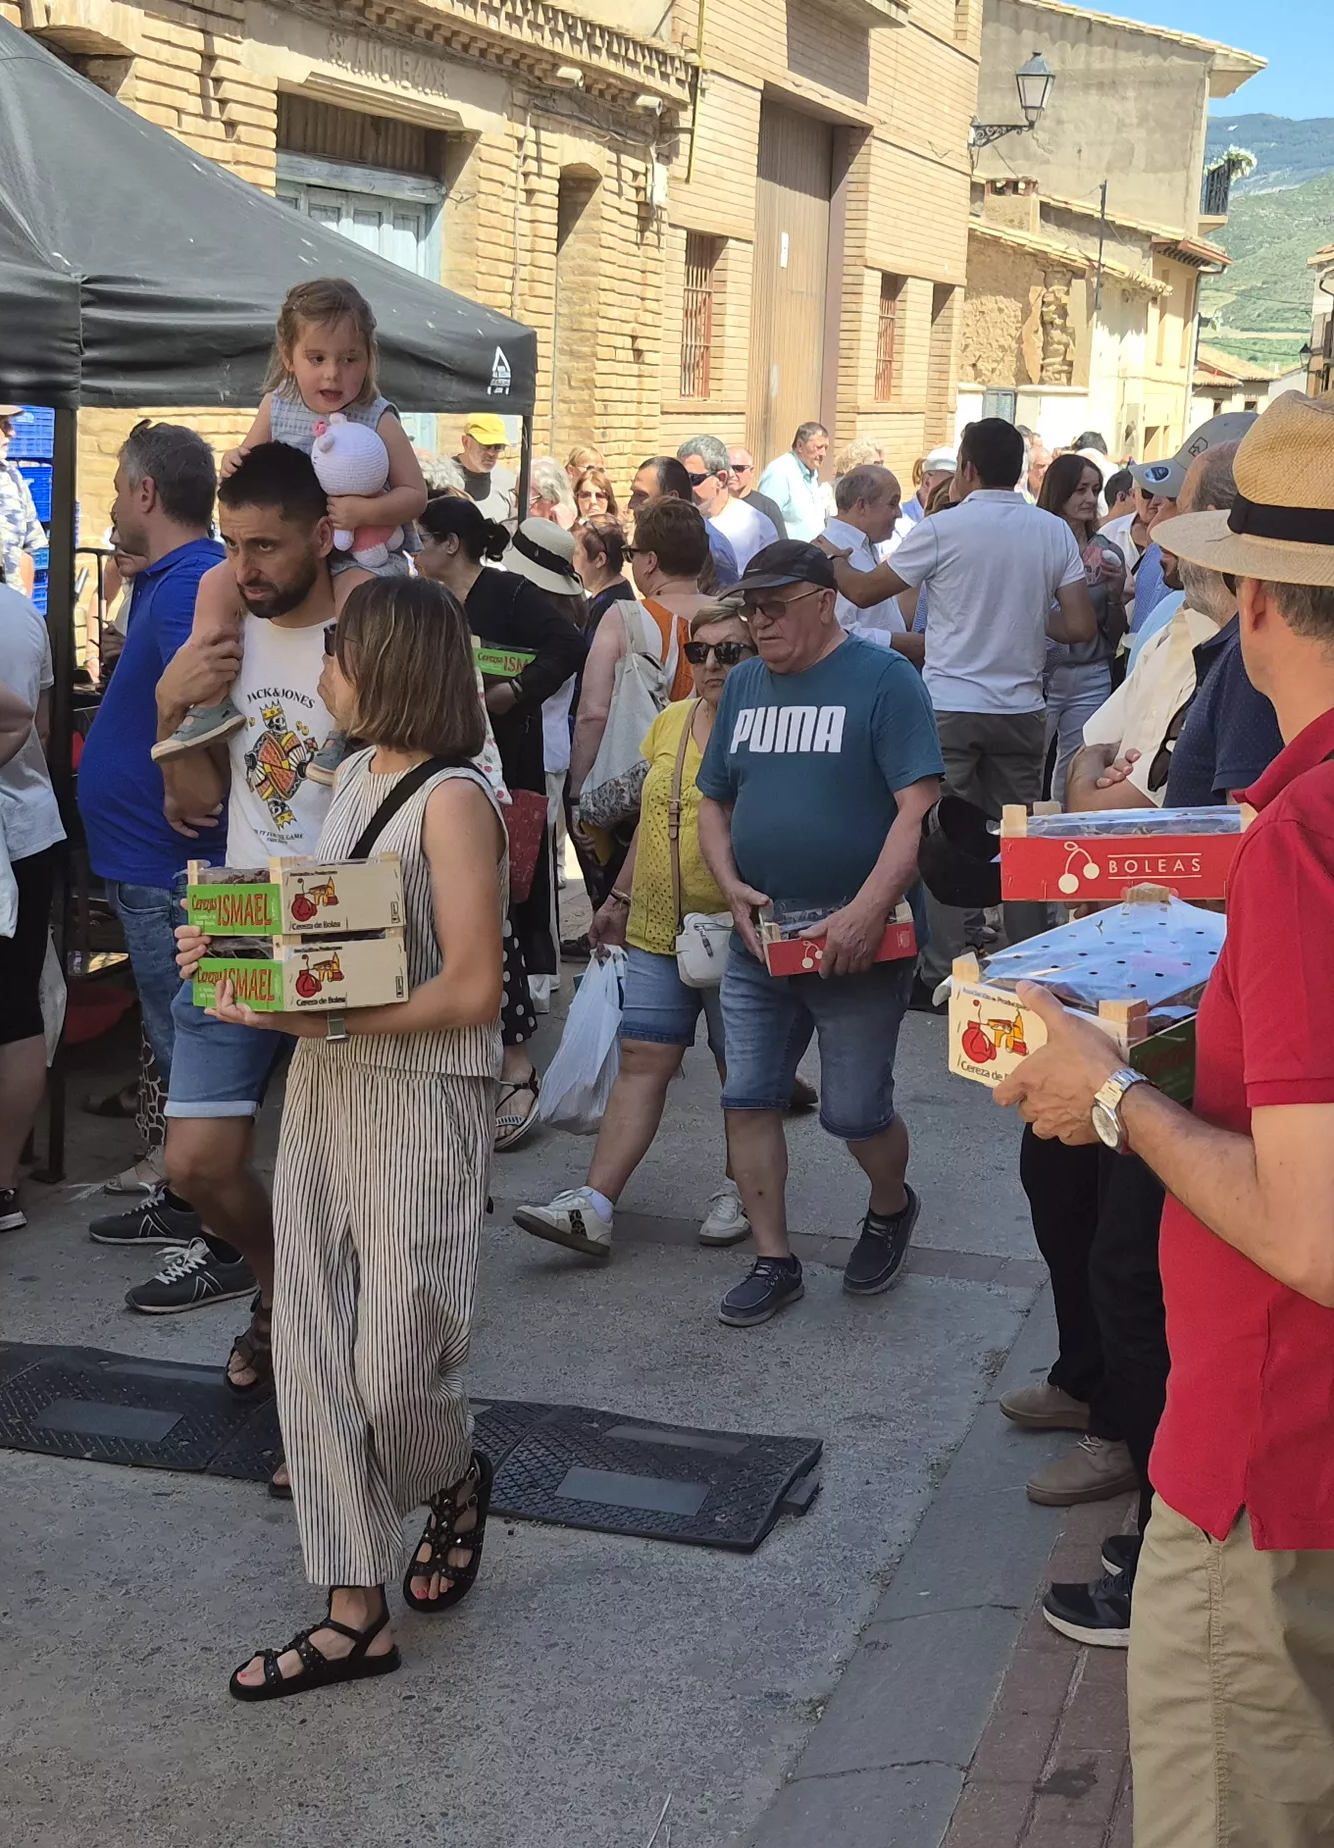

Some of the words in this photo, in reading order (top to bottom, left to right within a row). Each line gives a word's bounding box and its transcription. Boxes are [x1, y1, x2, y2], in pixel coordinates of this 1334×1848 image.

[247, 687, 315, 709] JACK&JONES
[729, 705, 846, 754] PUMA
[1108, 858, 1201, 874] BOLEAS
[217, 893, 272, 927] ISMAEL
[960, 1060, 991, 1079] Cereza
[991, 1069, 1004, 1083] de
